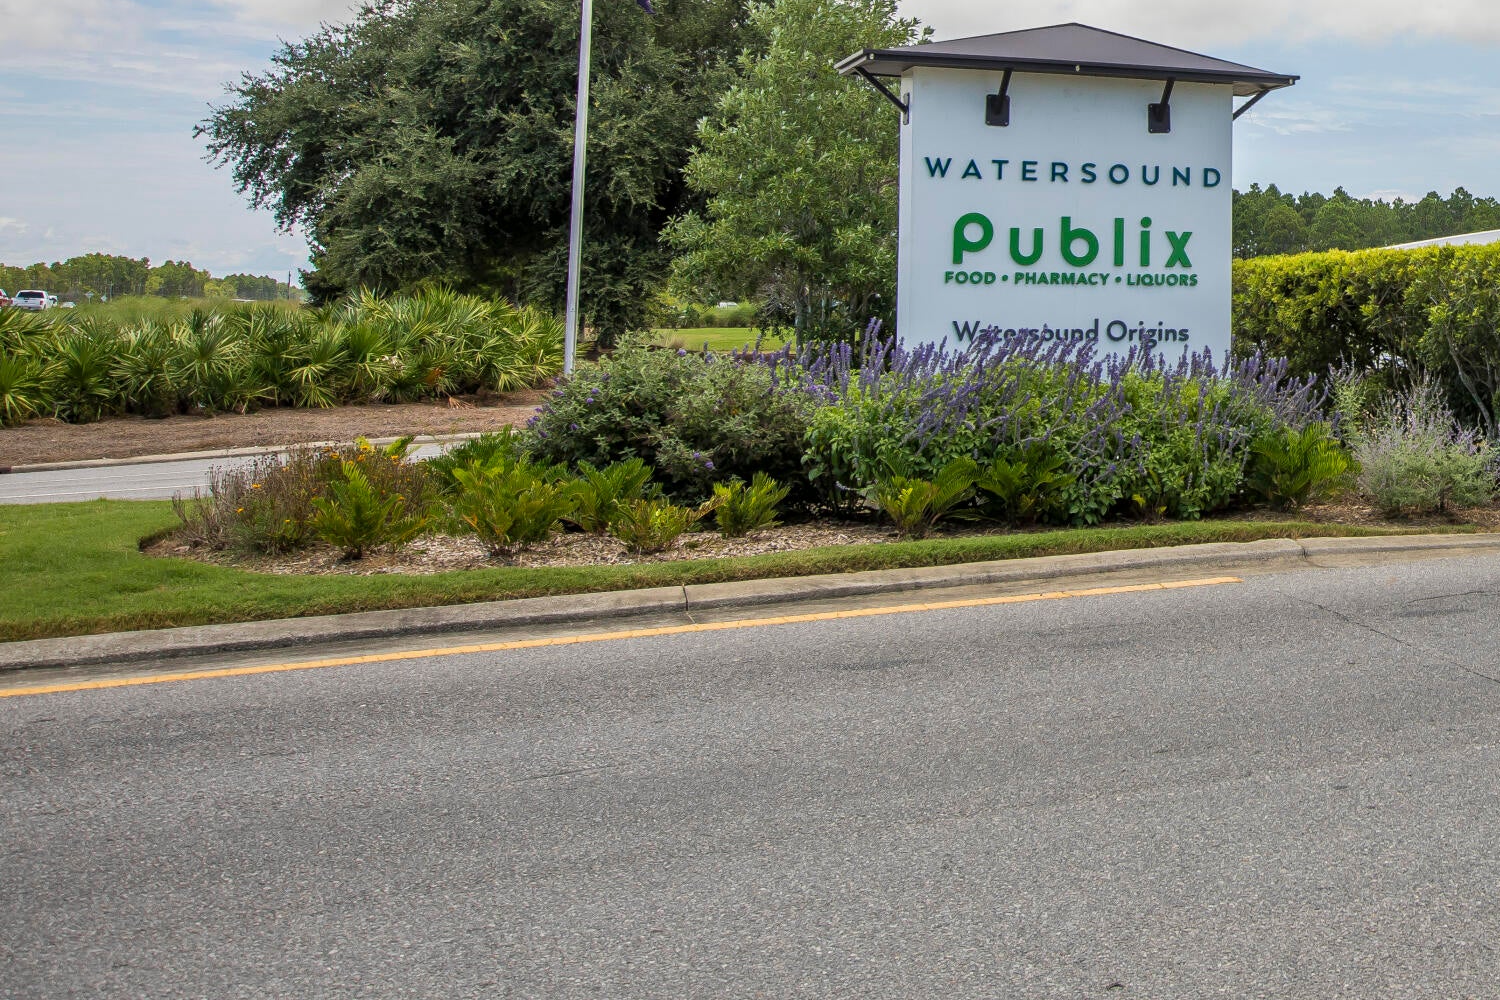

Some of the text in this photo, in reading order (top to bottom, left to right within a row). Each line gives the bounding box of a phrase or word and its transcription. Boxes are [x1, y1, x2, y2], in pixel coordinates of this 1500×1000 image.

[924, 156, 1221, 188] WATERSOUND
[952, 212, 1193, 268] Publix
[944, 270, 1199, 287] FOOD PHARMACY LIQUORS
[952, 318, 1190, 349] Wtesound Origins
